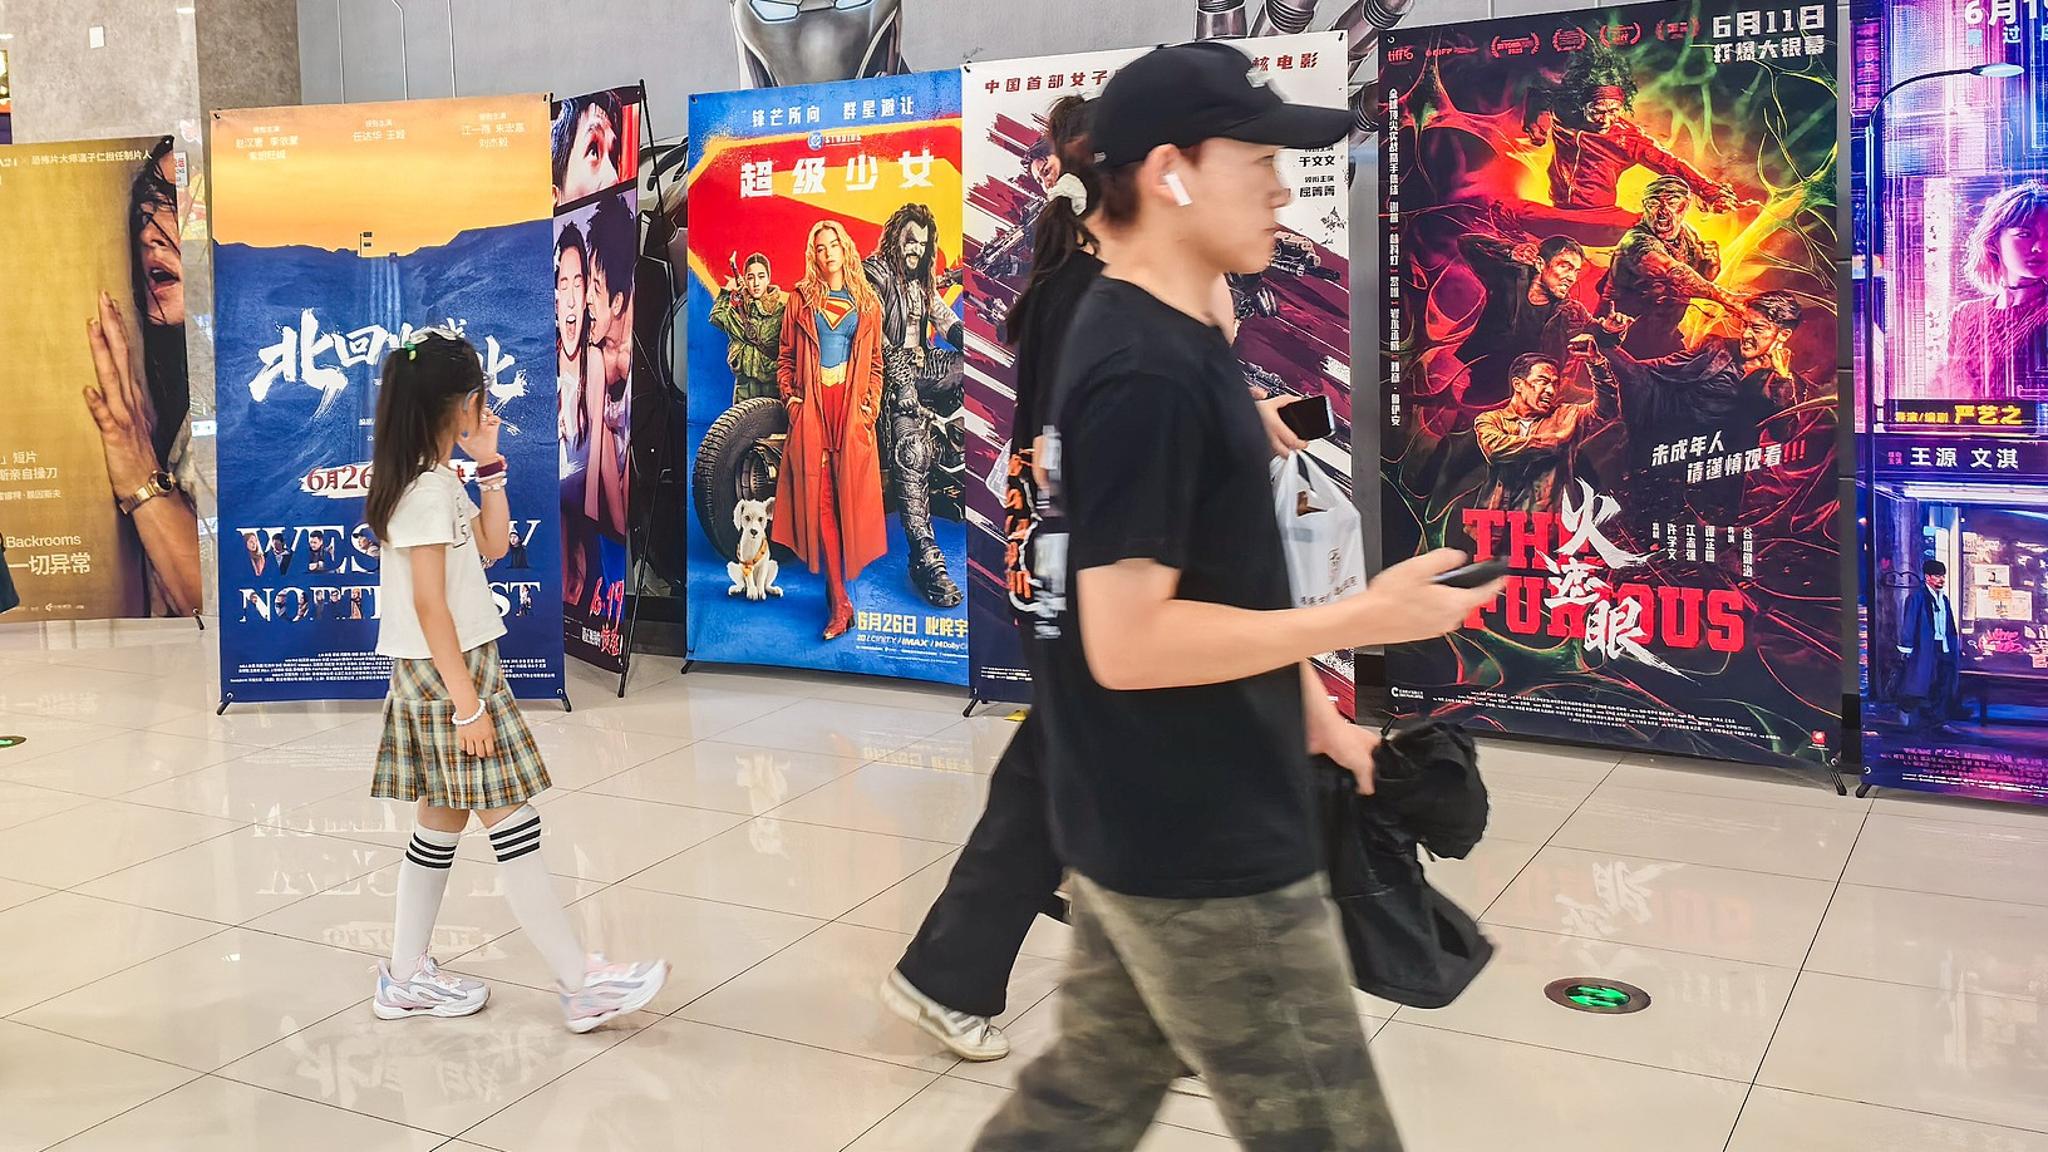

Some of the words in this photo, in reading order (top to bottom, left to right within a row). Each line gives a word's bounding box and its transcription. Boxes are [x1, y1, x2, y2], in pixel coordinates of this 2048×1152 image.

[1712, 5, 1825, 38] 6月11日
[1965, 0, 2048, 26] 6月1
[1713, 35, 1825, 64] 打爆大银幕
[985, 70, 1108, 94] 中国首部女子
[752, 107, 821, 128] 锋芒所向
[843, 96, 914, 119] 群星避让
[740, 148, 935, 199] 超级少女
[1954, 404, 2022, 425] 严艺之
[1651, 430, 1725, 467] 未成年人
[1910, 447, 1957, 467] 王源
[1970, 447, 2019, 469] 文淇
[6, 535, 82, 549] Backrooms
[8, 552, 92, 576] 一切异常
[1534, 476, 1702, 688] 火遮眼
[857, 610, 917, 634] 6月26日
[1461, 575, 1745, 653] UROUS
